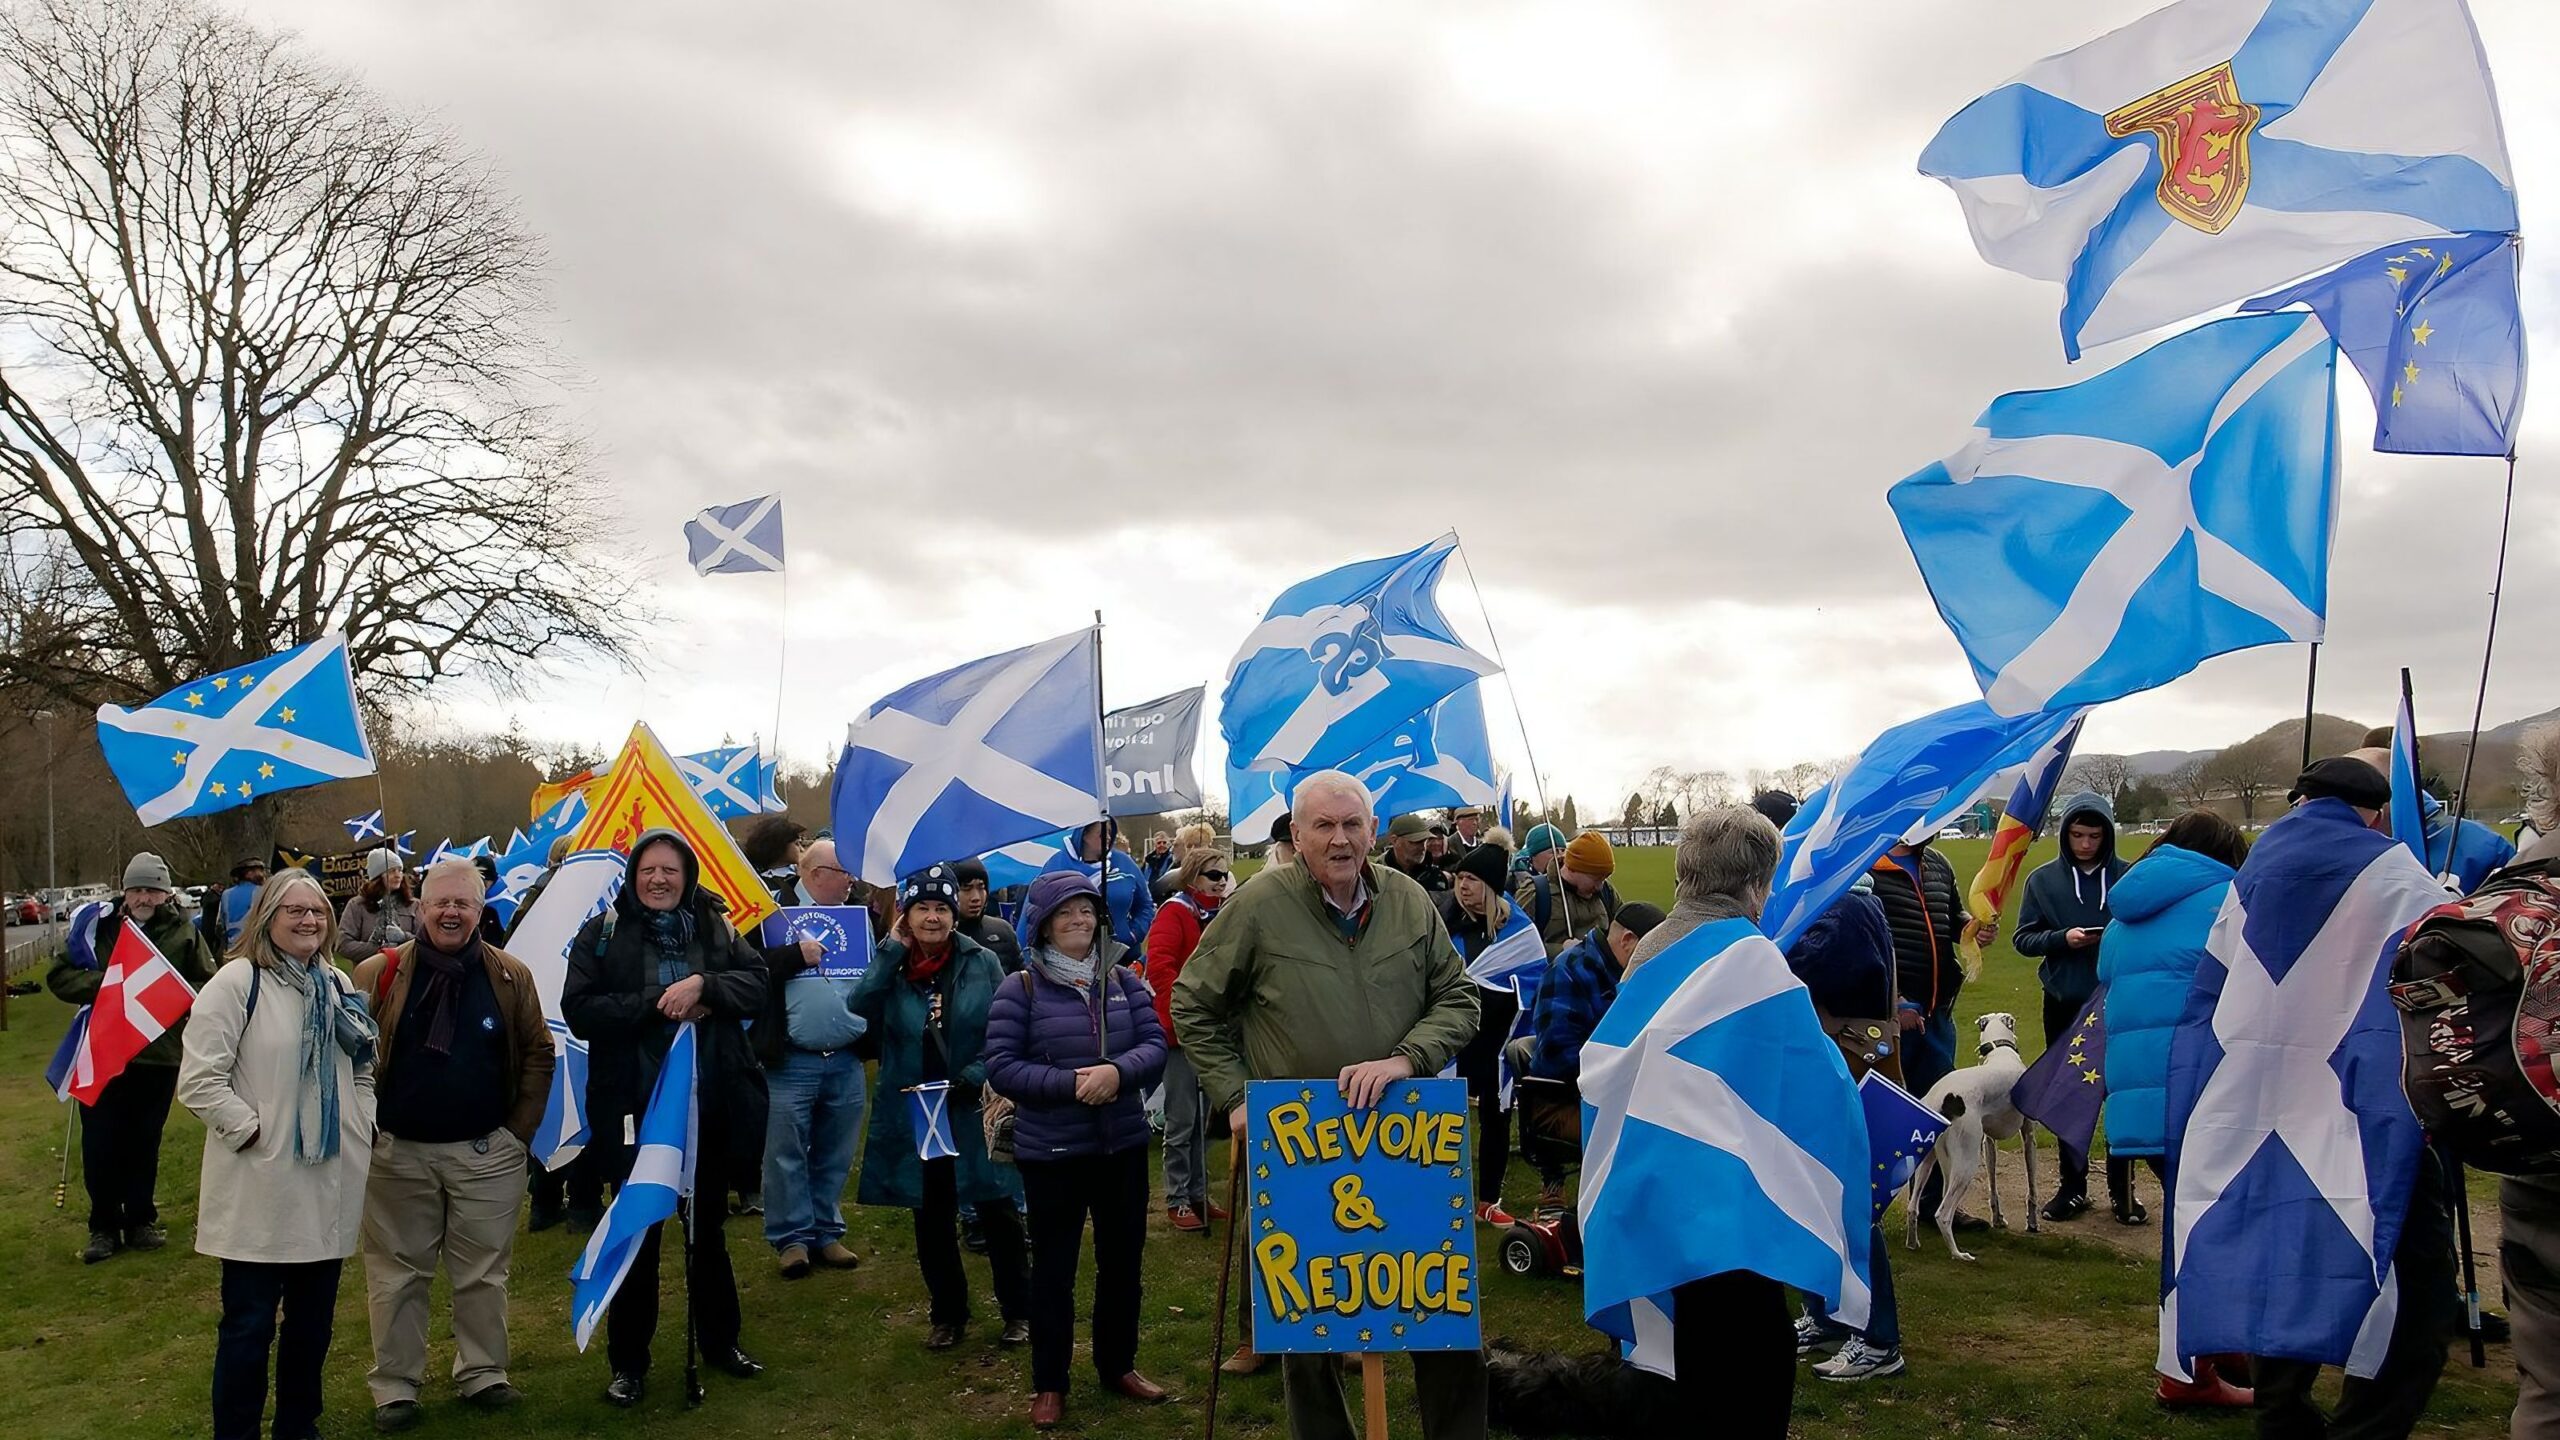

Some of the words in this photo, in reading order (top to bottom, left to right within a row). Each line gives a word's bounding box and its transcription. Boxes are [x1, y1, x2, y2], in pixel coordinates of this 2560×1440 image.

[1268, 1101, 1465, 1166] REVOKE
[1332, 1173, 1386, 1230] &
[1255, 1232, 1473, 1319] REJOICE
